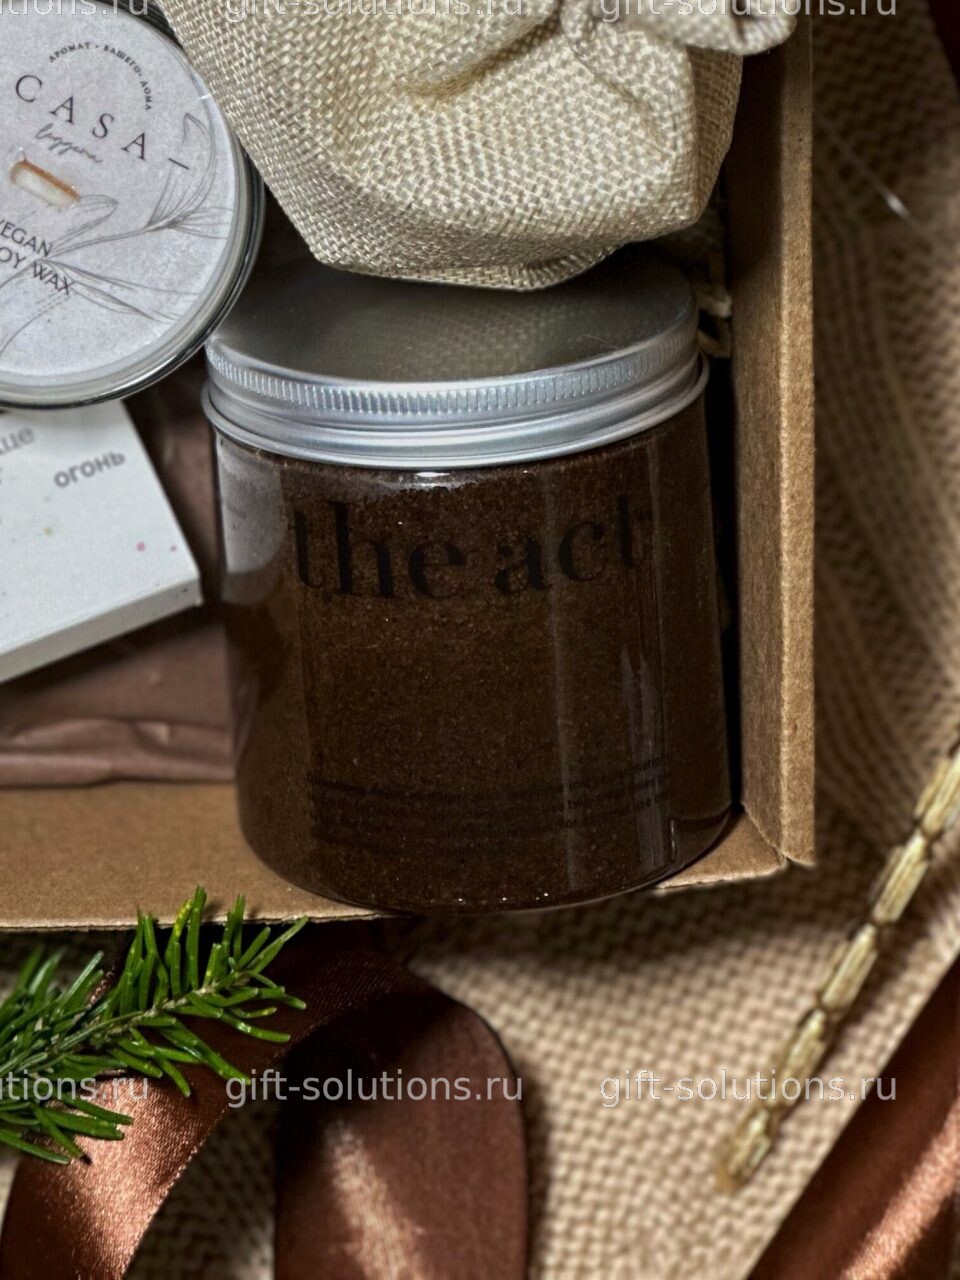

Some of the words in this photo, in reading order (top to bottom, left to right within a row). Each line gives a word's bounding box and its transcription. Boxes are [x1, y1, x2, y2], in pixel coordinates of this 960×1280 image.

[14, 74, 146, 161] CASA
[31, 260, 76, 296] WAX
[53, 451, 127, 488] огонь
[291, 499, 462, 599] the
